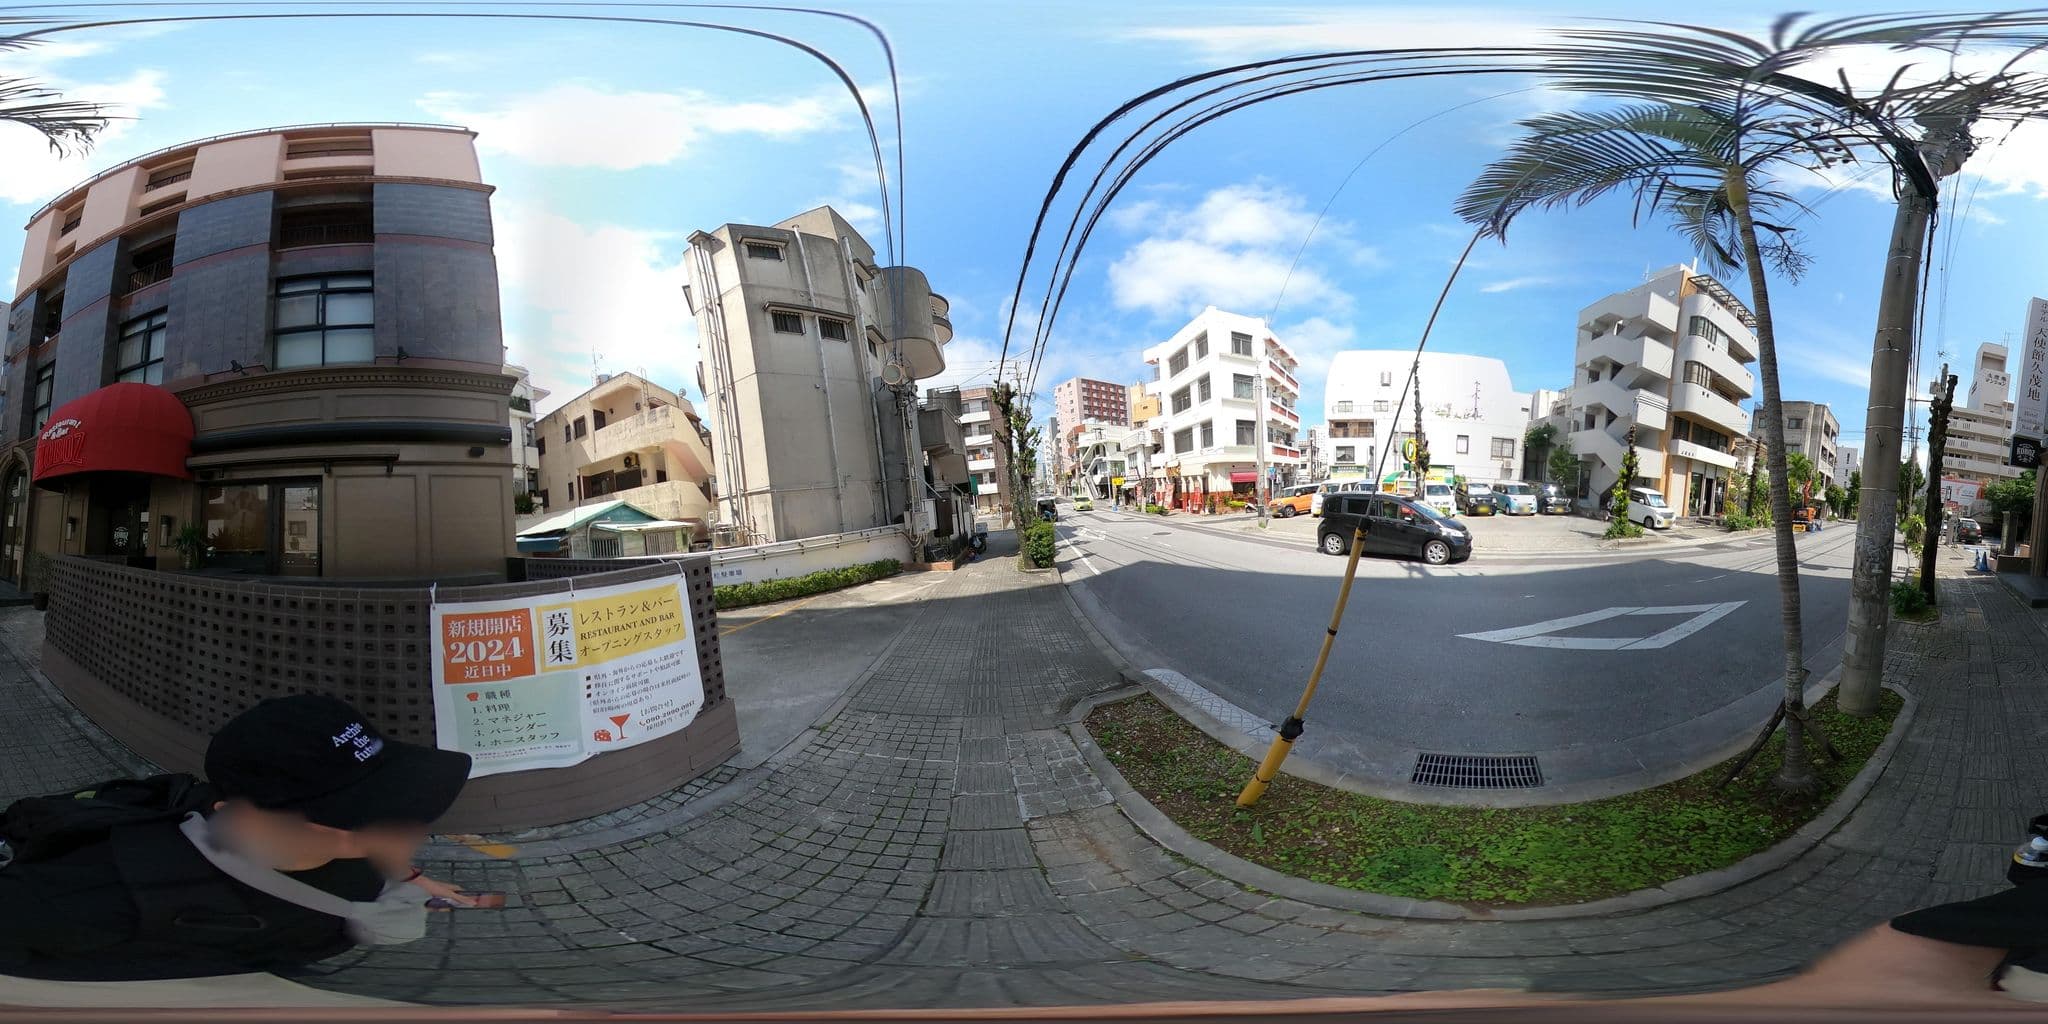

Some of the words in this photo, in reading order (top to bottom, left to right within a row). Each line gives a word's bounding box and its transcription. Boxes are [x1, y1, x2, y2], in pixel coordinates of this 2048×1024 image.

[2027, 327, 2048, 402] 天使館久茂地
[448, 615, 522, 638] 新規開店
[548, 612, 573, 663] 募集
[580, 620, 638, 640] RESTAURANT
[639, 615, 658, 628] AND
[659, 612, 675, 623] BAR
[449, 636, 525, 663] 2024
[580, 623, 681, 657] オープニングスタッフ
[464, 663, 511, 679] 近日中
[485, 689, 511, 700] 職種
[485, 703, 510, 713] 料理
[488, 712, 547, 724] マネジャー
[353, 734, 370, 749] the
